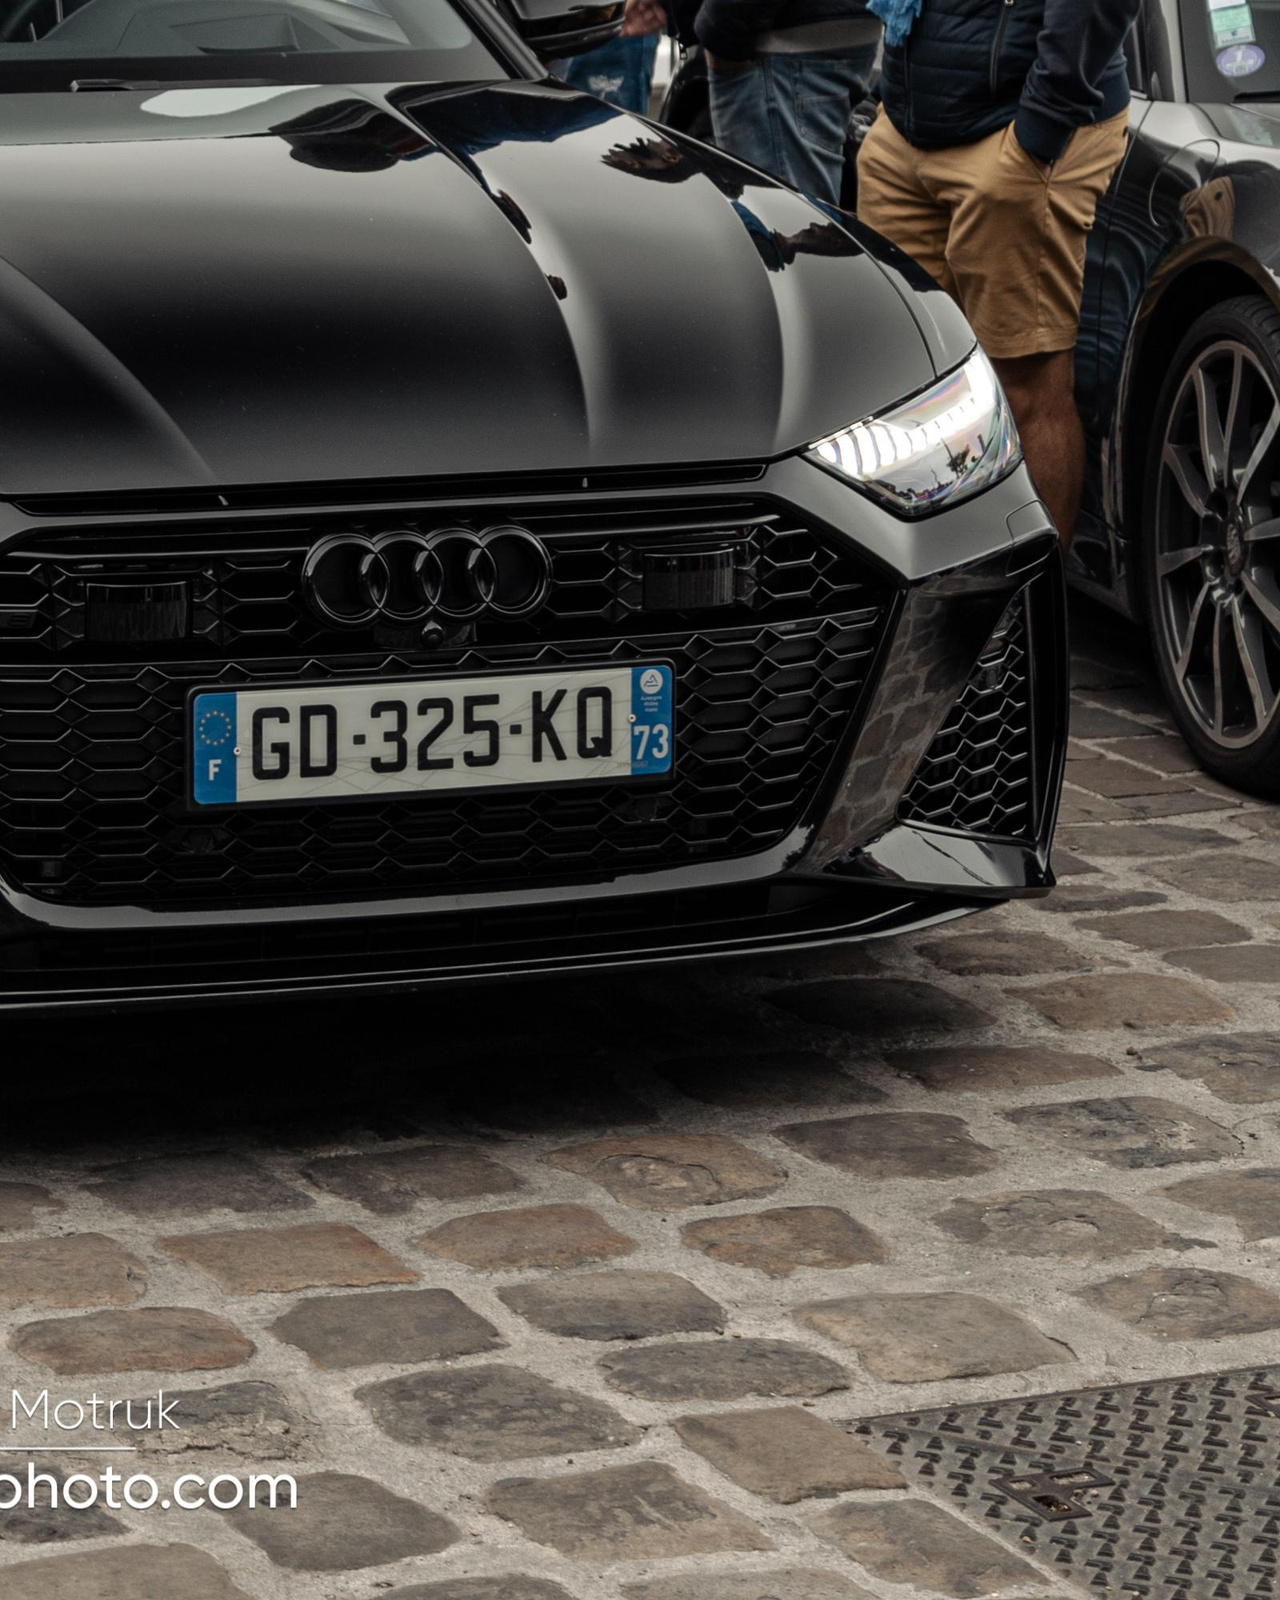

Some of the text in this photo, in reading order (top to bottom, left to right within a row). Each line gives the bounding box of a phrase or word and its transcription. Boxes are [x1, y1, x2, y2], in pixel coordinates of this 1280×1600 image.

[252, 686, 612, 780] GD-325-KQ
[633, 724, 669, 760] 73
[209, 759, 222, 780] F
